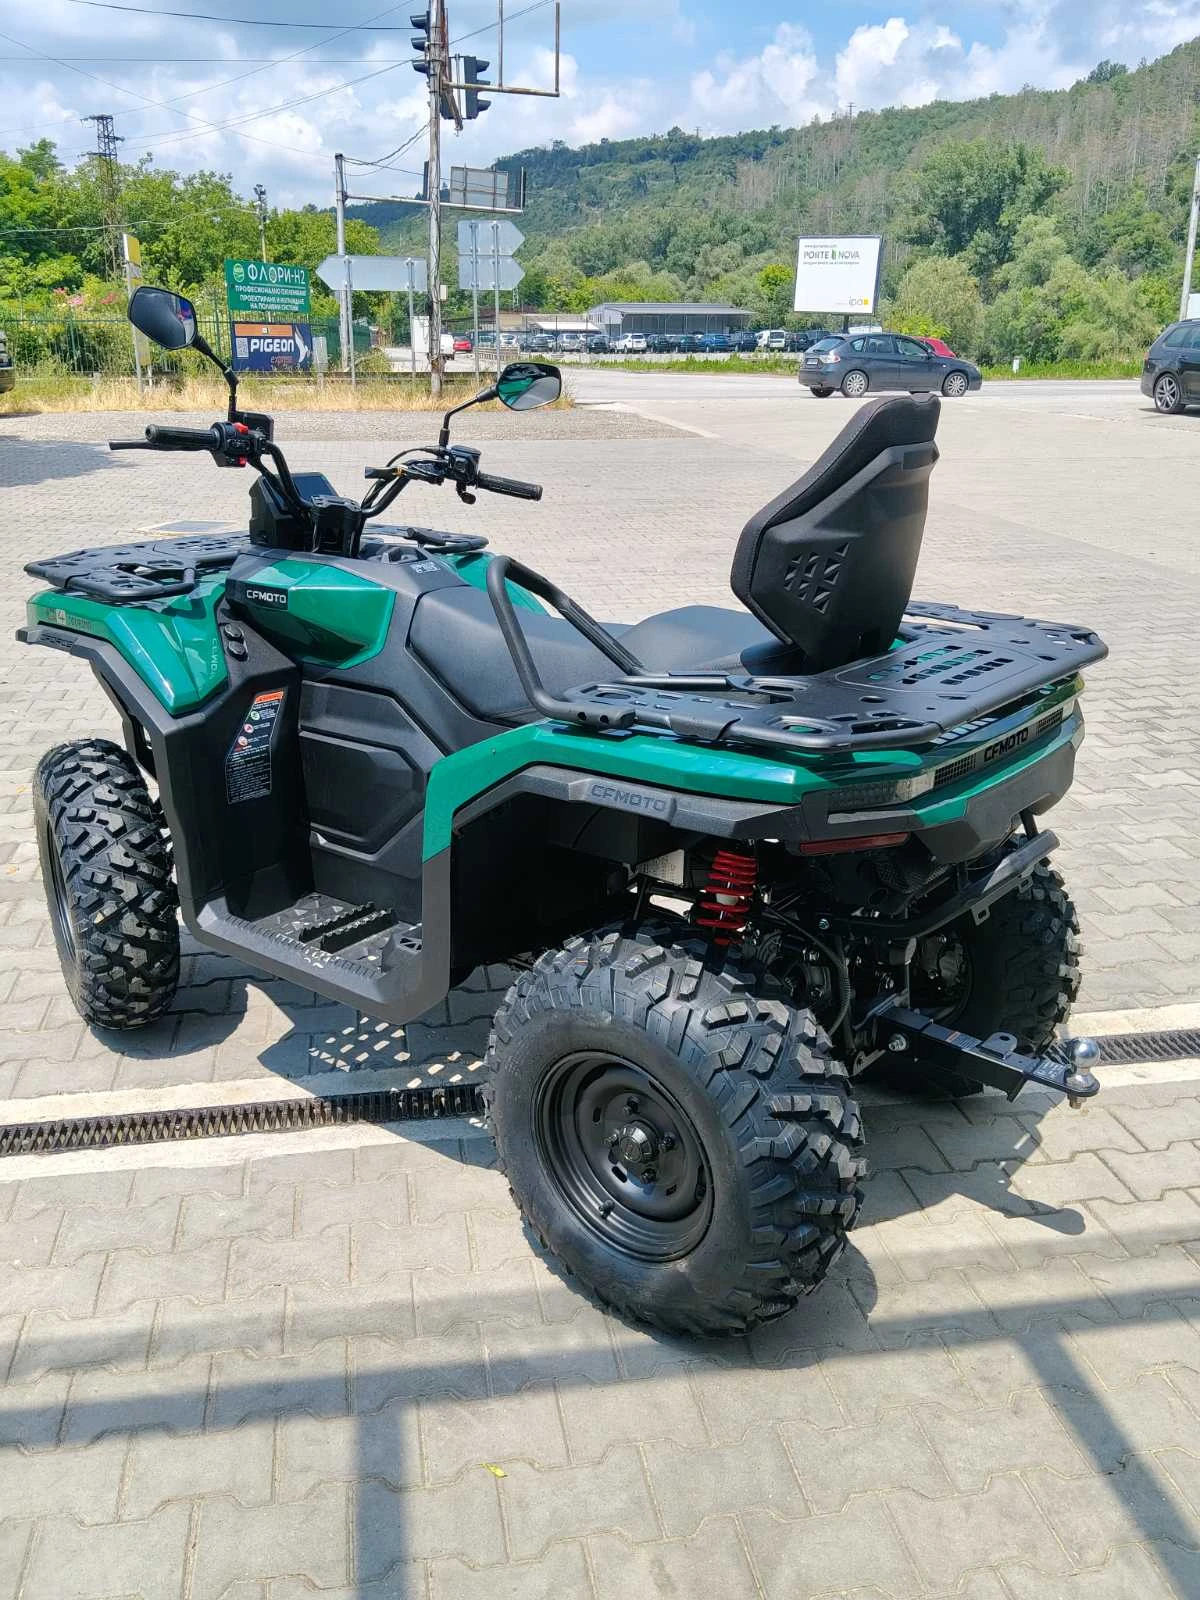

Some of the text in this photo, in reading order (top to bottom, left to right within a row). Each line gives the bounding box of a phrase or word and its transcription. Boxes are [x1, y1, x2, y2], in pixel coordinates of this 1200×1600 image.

[248, 263, 306, 284] ФЛОРИ-Н2
[250, 338, 295, 353] PIGEON
[246, 589, 287, 604] CFMOTO
[984, 727, 1029, 762] CFMOTO
[591, 784, 666, 812] CFMOTO
